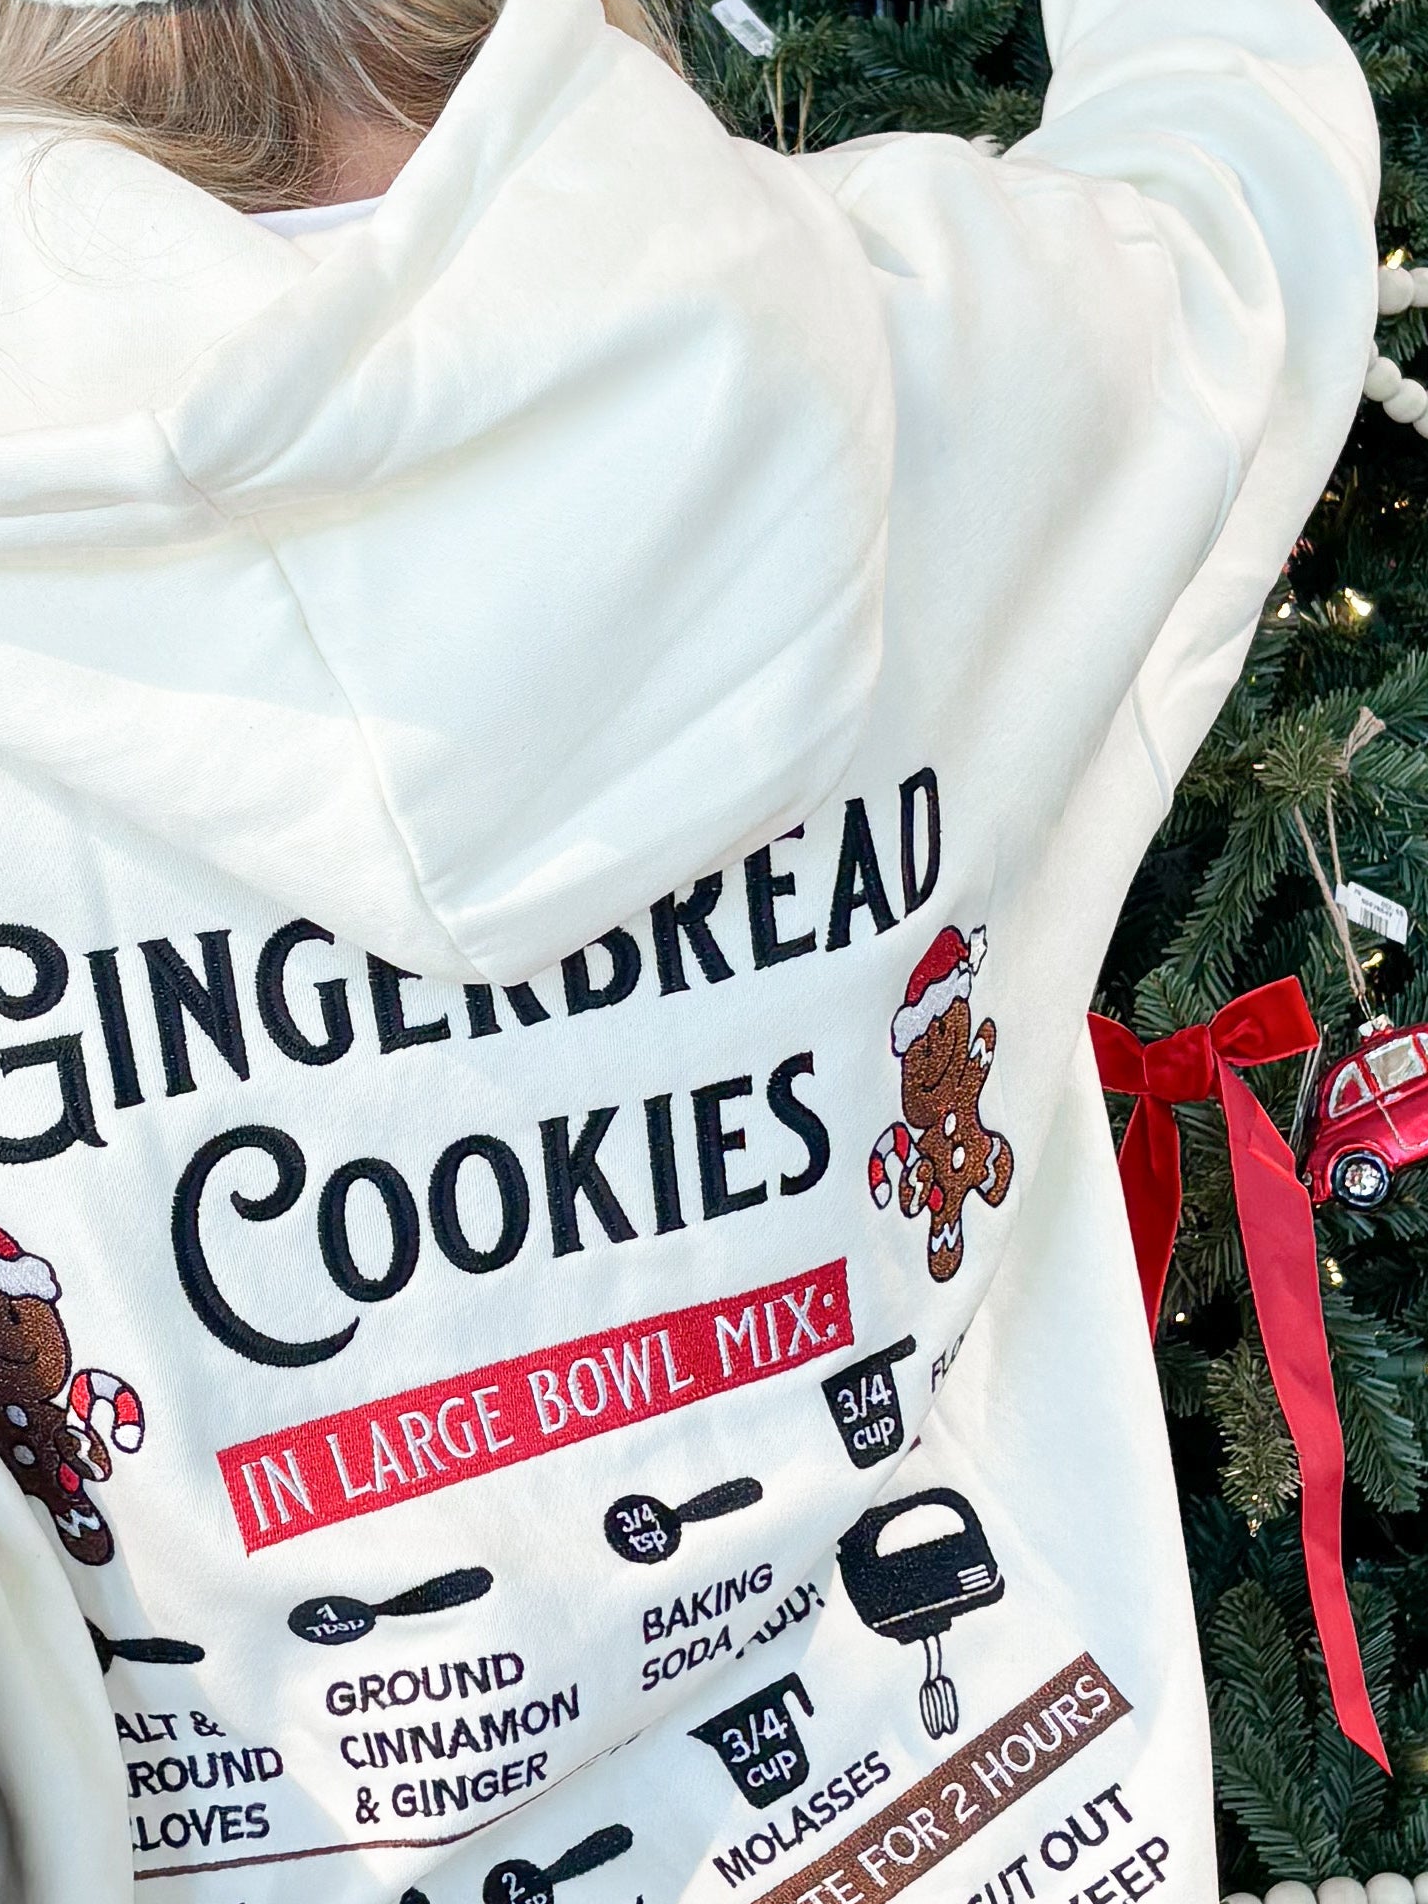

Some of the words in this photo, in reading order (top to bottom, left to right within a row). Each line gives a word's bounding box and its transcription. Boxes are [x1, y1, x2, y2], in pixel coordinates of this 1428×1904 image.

[171, 1052, 830, 1367] COOKIES
[241, 1452, 316, 1532] IN
[325, 1386, 516, 1501] LARGE
[530, 1331, 694, 1437] BOWL
[713, 1285, 839, 1379] MIX:
[836, 1374, 892, 1424] 3/4
[852, 1416, 896, 1452] cup
[616, 1503, 661, 1533] 3/4
[628, 1529, 668, 1553] tsp
[315, 1603, 339, 1623] 1
[642, 1563, 773, 1645] BAKING
[325, 1651, 525, 1716] GROUND
[641, 1625, 733, 1692] SODA
[114, 1712, 179, 1744] ALT
[188, 1710, 227, 1738] &
[340, 1682, 580, 1770] CINNAMON
[722, 1707, 789, 1764] 3/4
[127, 1746, 284, 1798] ROUND
[355, 1786, 381, 1825] &
[391, 1750, 549, 1818] GINGER
[745, 1753, 798, 1788] cup
[857, 1809, 952, 1891] FOR
[940, 1780, 980, 1825] 2
[978, 1673, 1113, 1795] HOURS
[129, 1802, 271, 1852] LOVES
[712, 1750, 892, 1888] MOLASSES
[1039, 1782, 1135, 1872] OUT
[501, 1871, 527, 1898] 2
